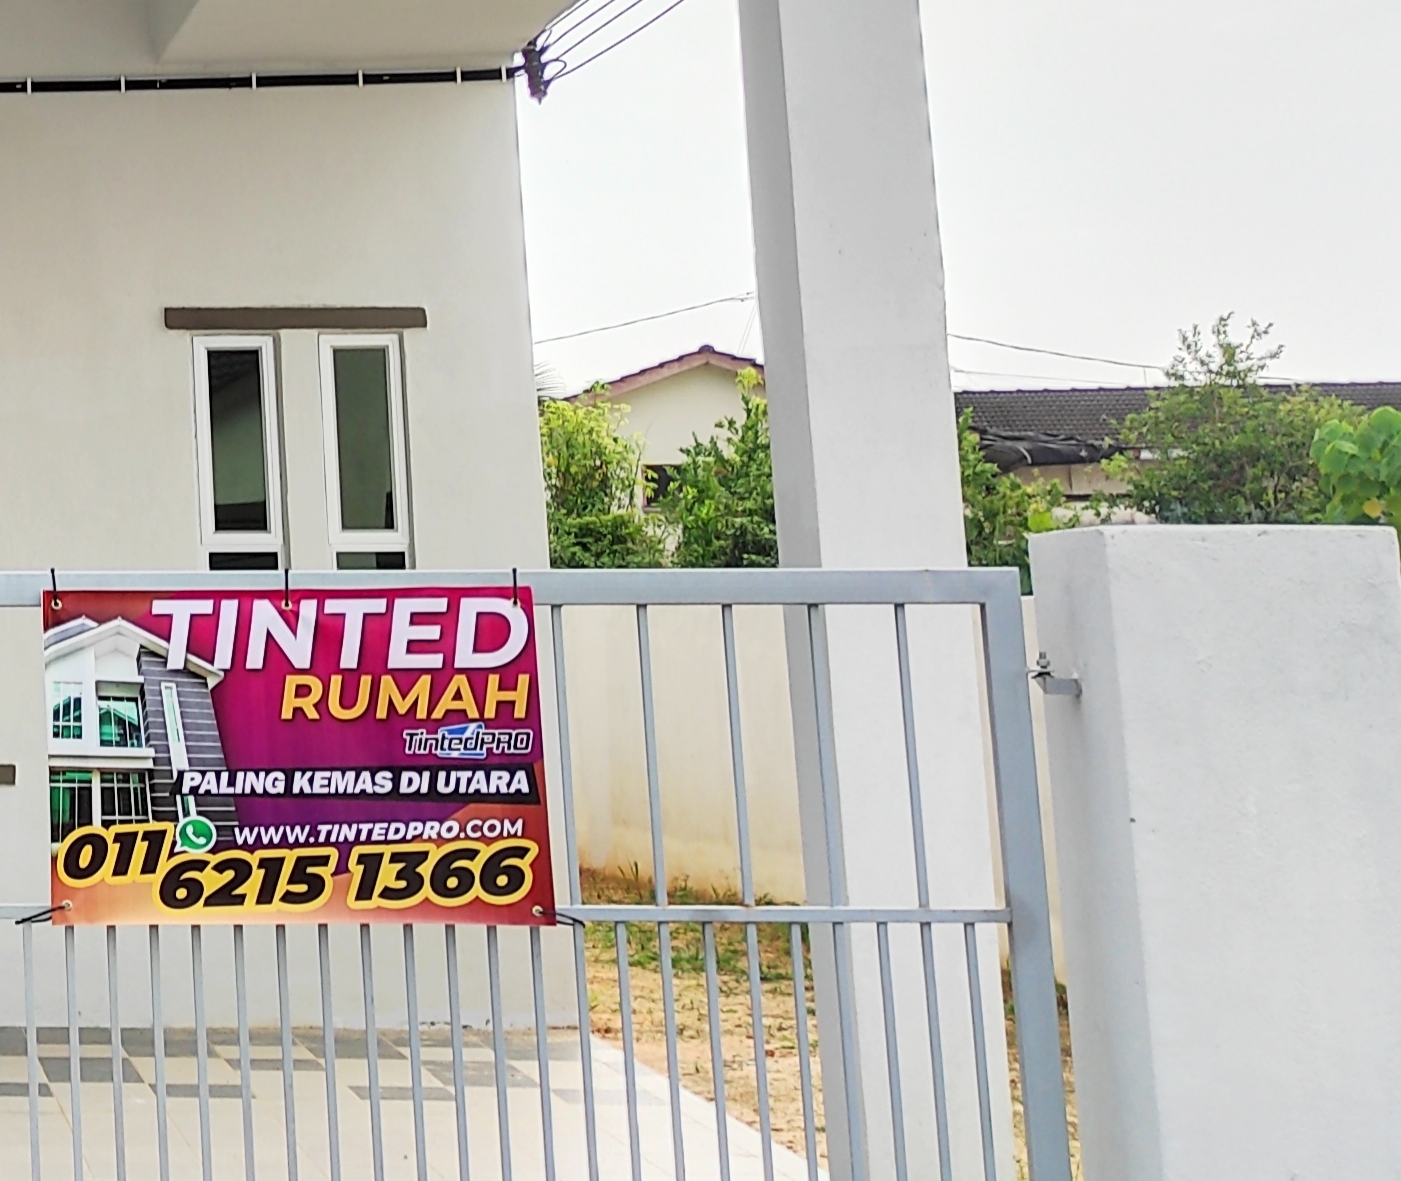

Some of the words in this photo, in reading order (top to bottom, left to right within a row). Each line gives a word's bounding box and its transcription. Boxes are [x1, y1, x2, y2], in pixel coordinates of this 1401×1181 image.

[151, 597, 530, 671] TINTED
[280, 673, 531, 720] RUMAH
[403, 727, 532, 755] TintedPRO
[181, 769, 286, 795] PALING
[292, 769, 393, 794] KEMAS
[399, 769, 433, 794] DI
[437, 769, 530, 794] UTARA
[234, 818, 524, 845] WWW.TINTEDPRO.COM
[62, 827, 170, 881] 011
[158, 853, 331, 910] 6215
[352, 845, 531, 902] 1366
